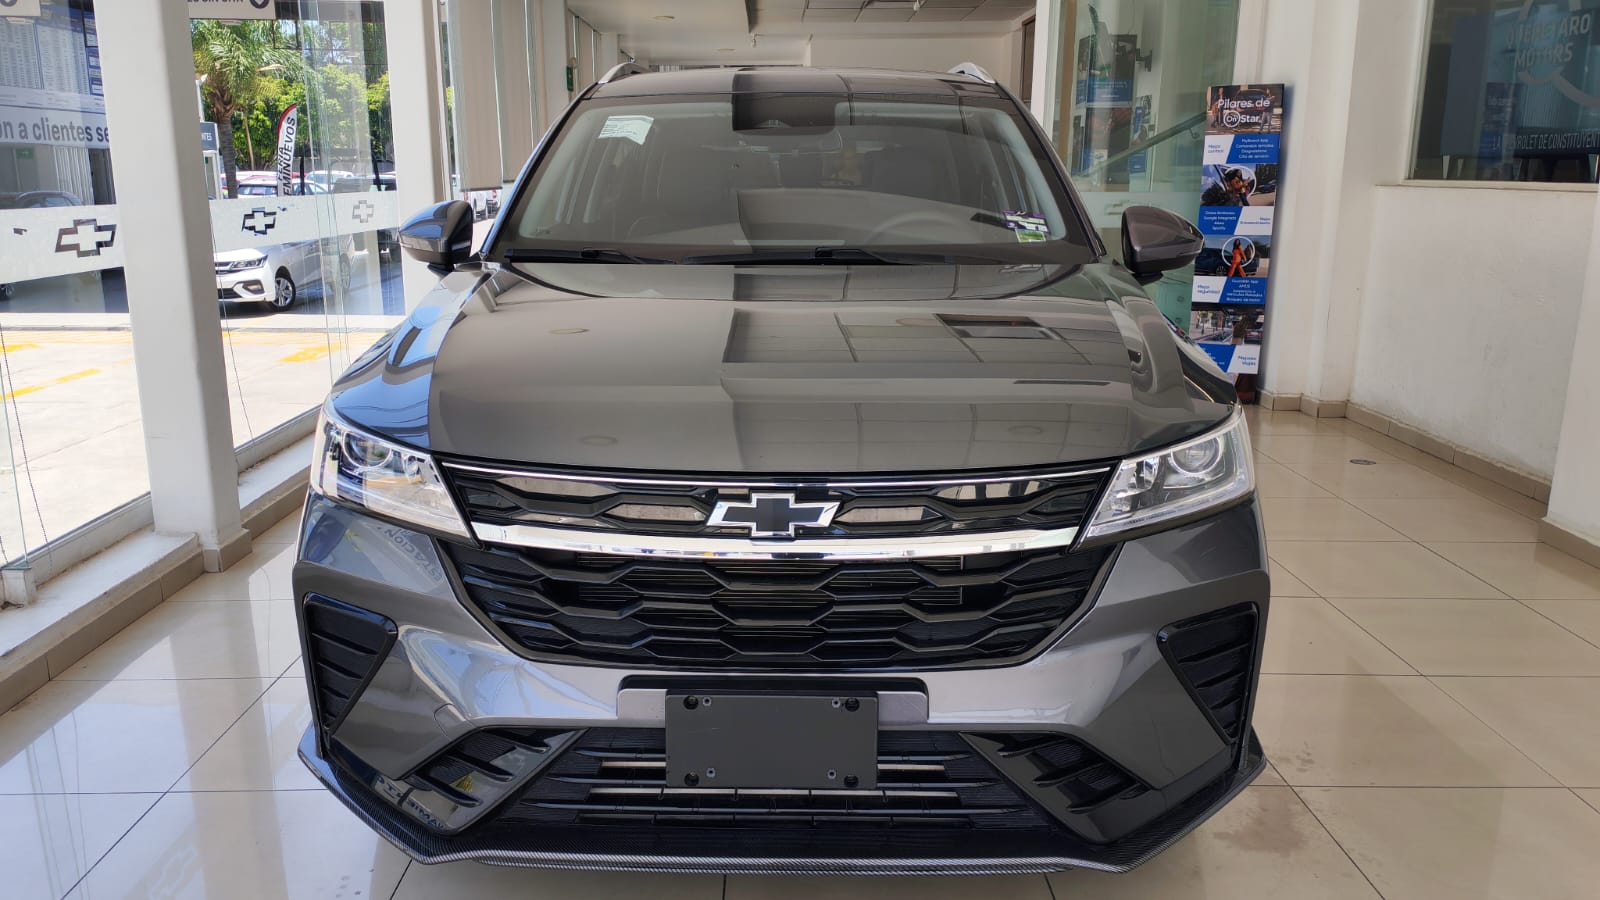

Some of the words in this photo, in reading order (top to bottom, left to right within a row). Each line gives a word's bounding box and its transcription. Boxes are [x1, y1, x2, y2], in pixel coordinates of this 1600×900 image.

[1517, 42, 1574, 68] MOTORS
[1217, 98, 1253, 109] Pilares
[1255, 97, 1271, 108] de
[0, 119, 14, 139] n
[18, 121, 28, 140] a
[33, 117, 93, 142] clientes
[1539, 134, 1549, 150] DE
[282, 116, 296, 196] EMINUEVOS
